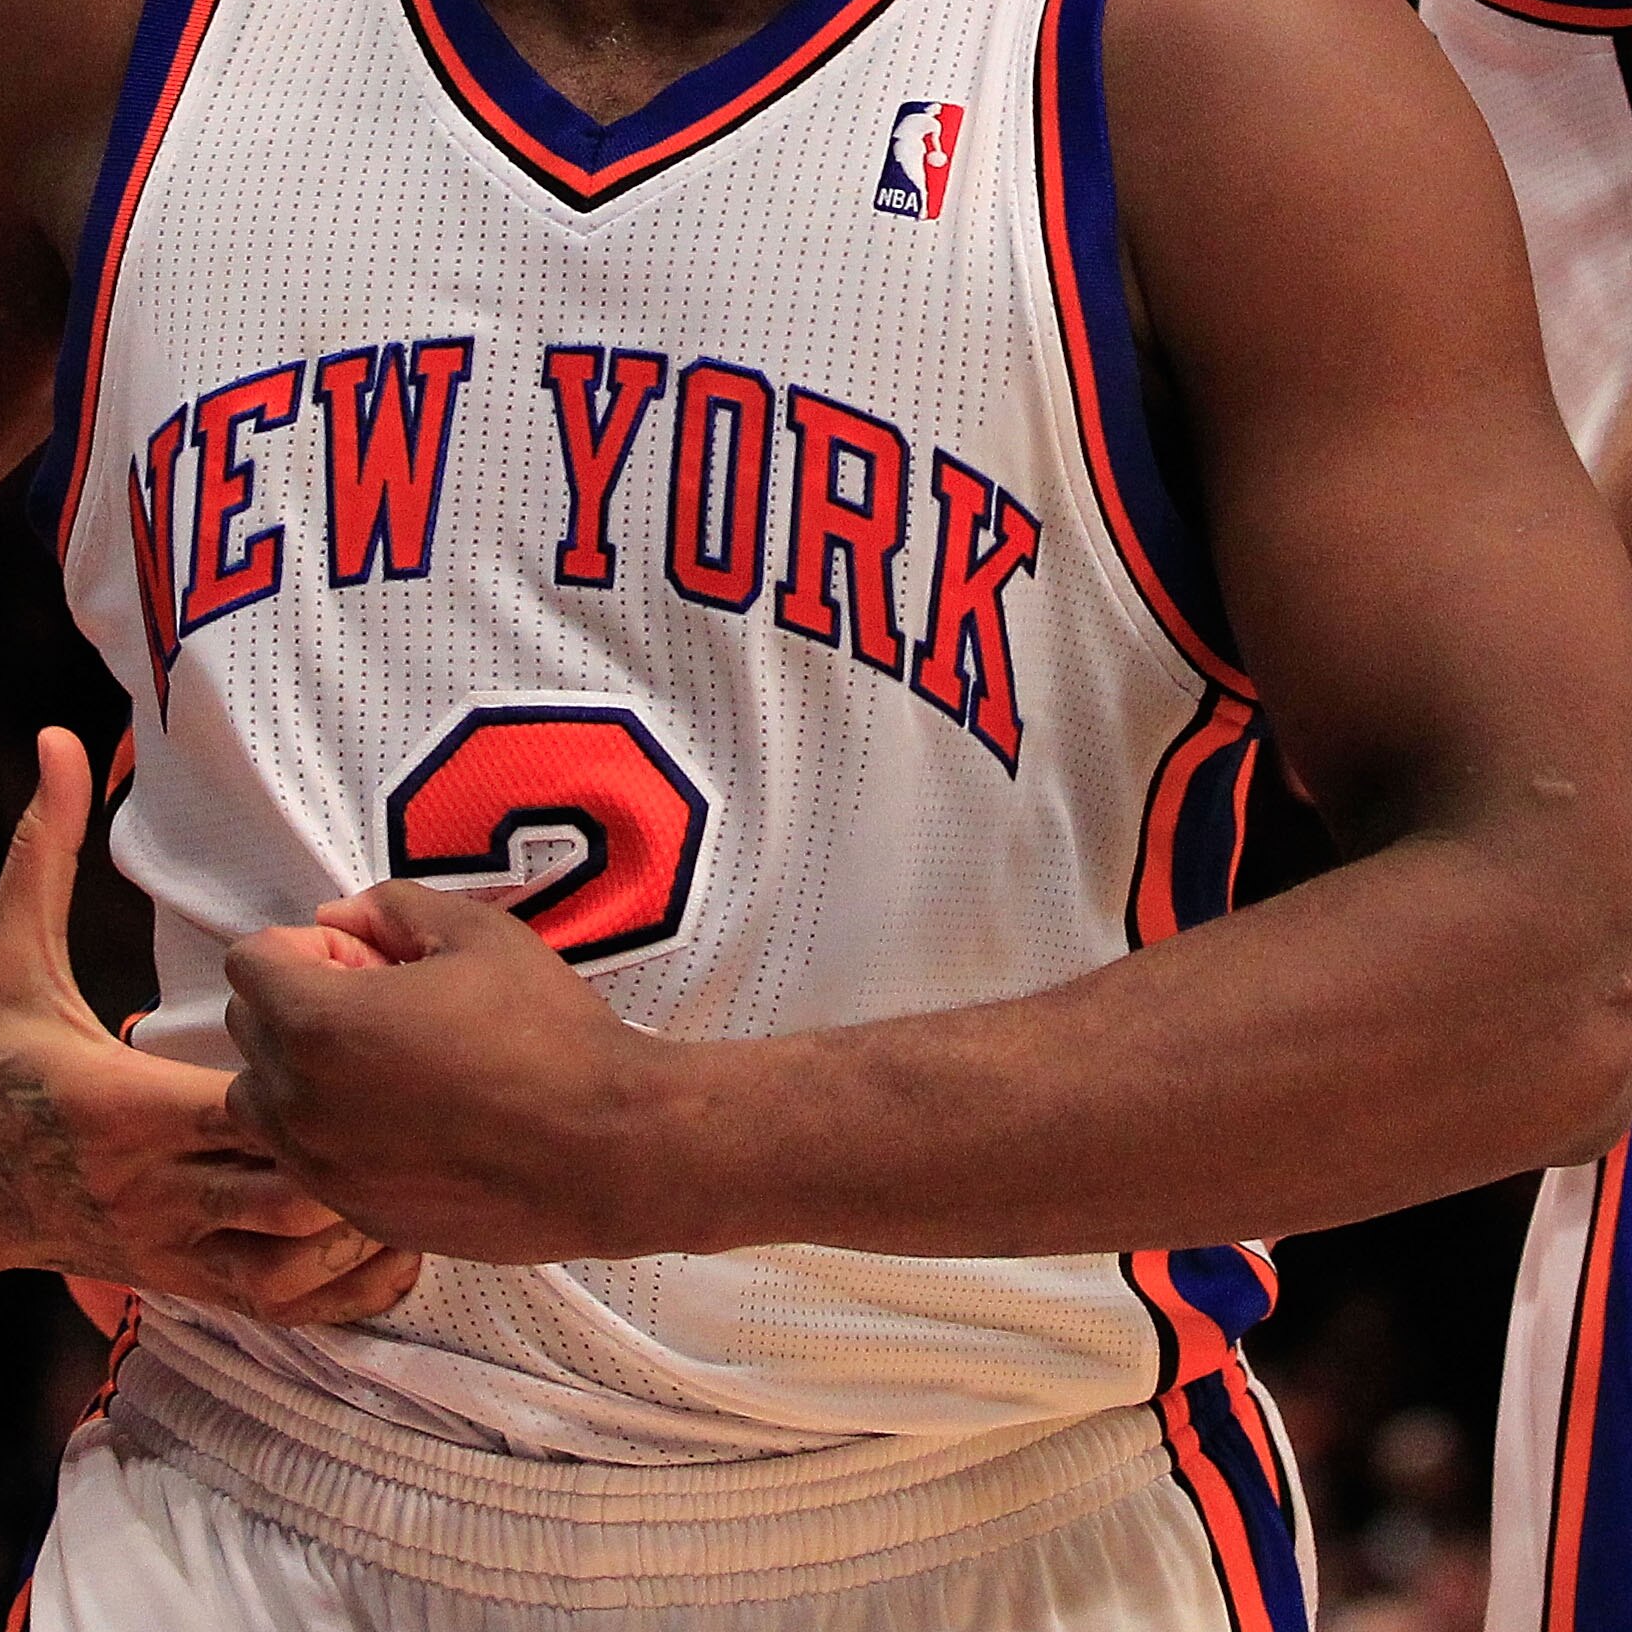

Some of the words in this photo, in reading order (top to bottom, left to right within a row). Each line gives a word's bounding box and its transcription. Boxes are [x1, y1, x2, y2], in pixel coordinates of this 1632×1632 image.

[876, 187, 919, 213] NBA
[129, 335, 473, 733] NEW
[540, 341, 1042, 781] YORK
[385, 704, 710, 968] 2
